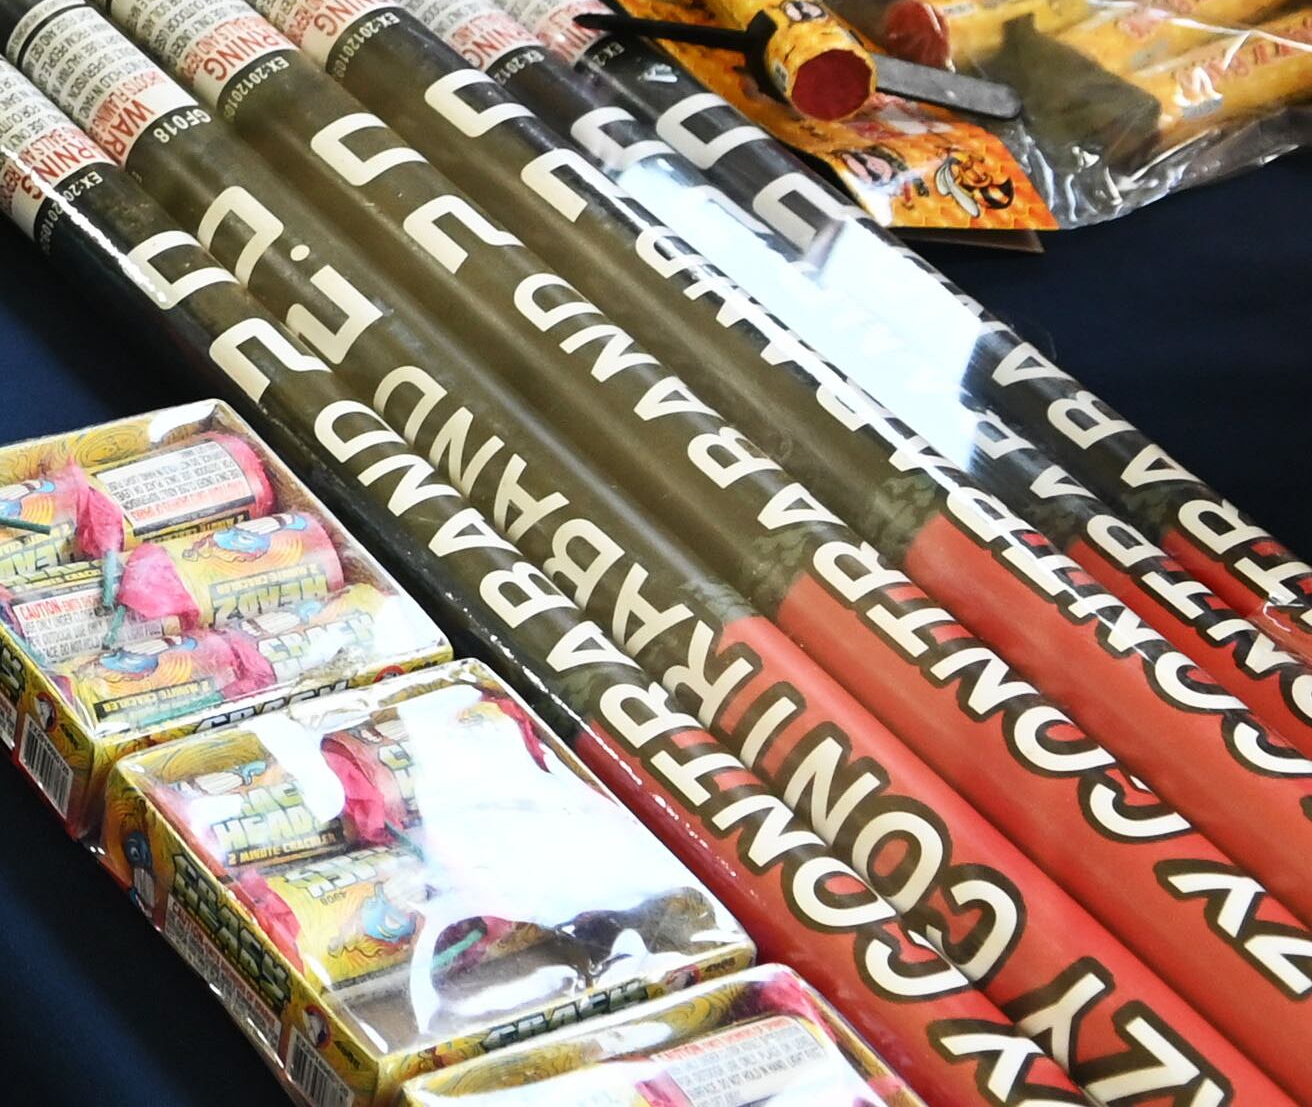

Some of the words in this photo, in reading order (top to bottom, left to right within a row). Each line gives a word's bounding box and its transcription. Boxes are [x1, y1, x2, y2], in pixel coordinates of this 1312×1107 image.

[150, 96, 211, 155] GF018
[18, 597, 62, 622] CAUTION
[373, 363, 1019, 982] CONTRABAND
[239, 841, 280, 864] MINUTE
